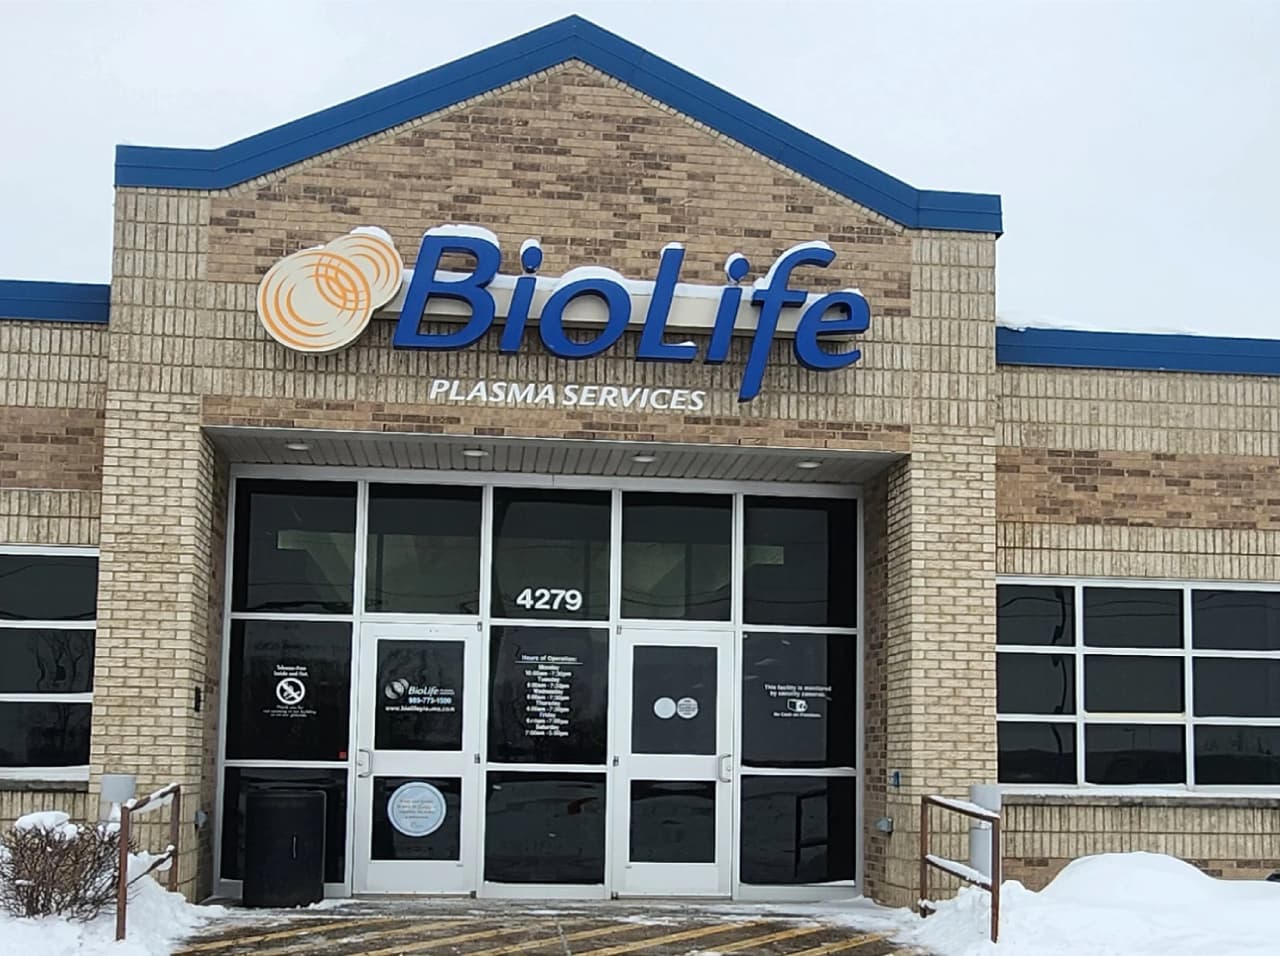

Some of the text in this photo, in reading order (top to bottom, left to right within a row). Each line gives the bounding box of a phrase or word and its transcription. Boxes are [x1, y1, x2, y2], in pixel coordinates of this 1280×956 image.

[393, 234, 871, 403] BioLife
[429, 379, 707, 411] PLASMA SERVICES
[516, 588, 583, 611] 4279
[408, 685, 439, 697] BioLife
